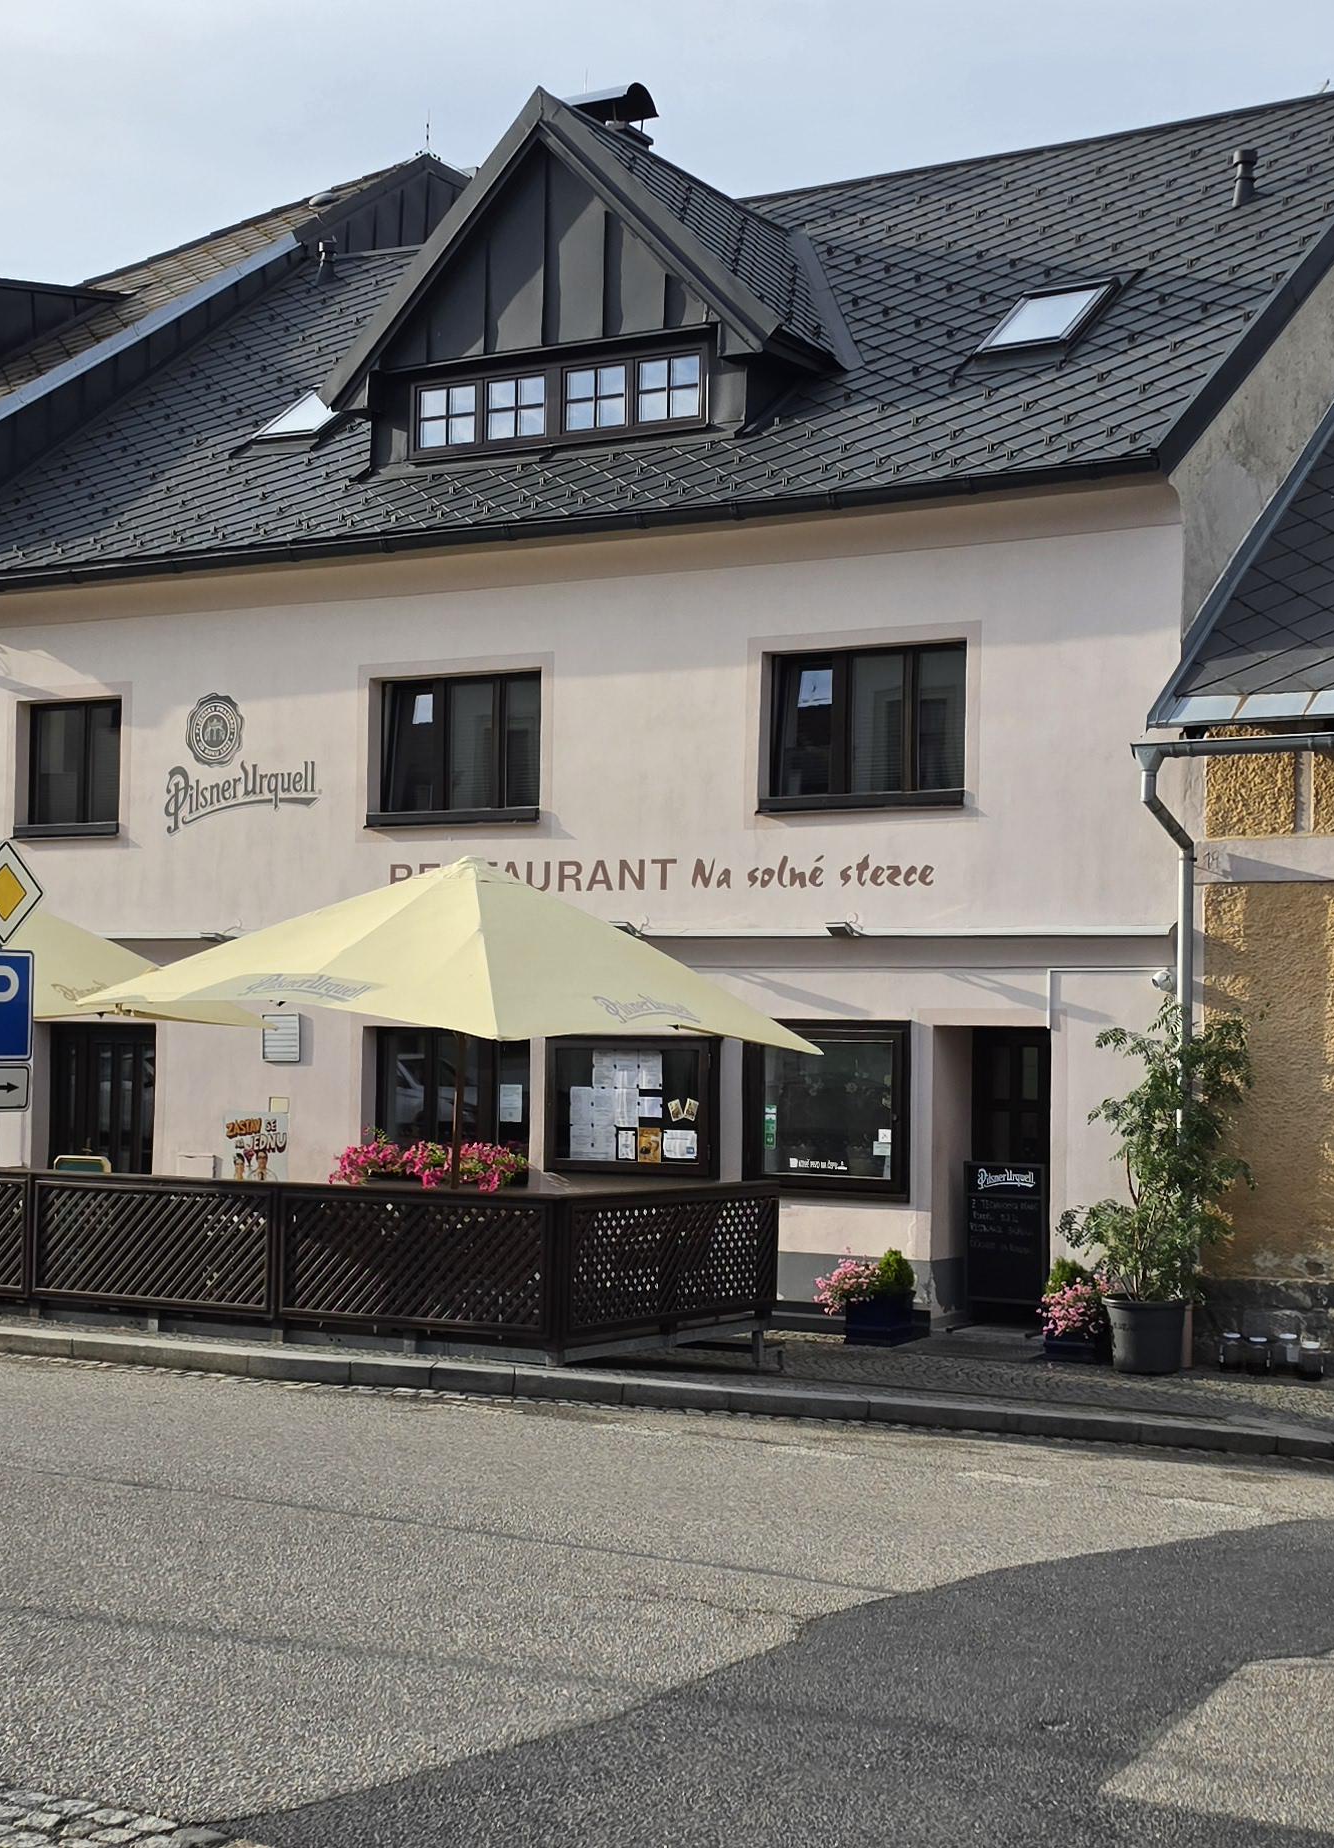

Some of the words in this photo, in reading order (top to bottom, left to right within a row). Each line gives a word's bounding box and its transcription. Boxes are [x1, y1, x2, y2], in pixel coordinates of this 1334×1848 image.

[165, 766, 241, 833] Pilsner
[240, 760, 315, 810] Urquell
[692, 858, 731, 888] Na
[747, 855, 824, 888] solné
[839, 854, 934, 887] stezce
[226, 1117, 262, 1139] ZASTAV
[265, 1119, 277, 1132] SE
[246, 1132, 287, 1153] JEDNU
[977, 1168, 1007, 1190] Pilsner
[1004, 1168, 1034, 1187] Urquell
